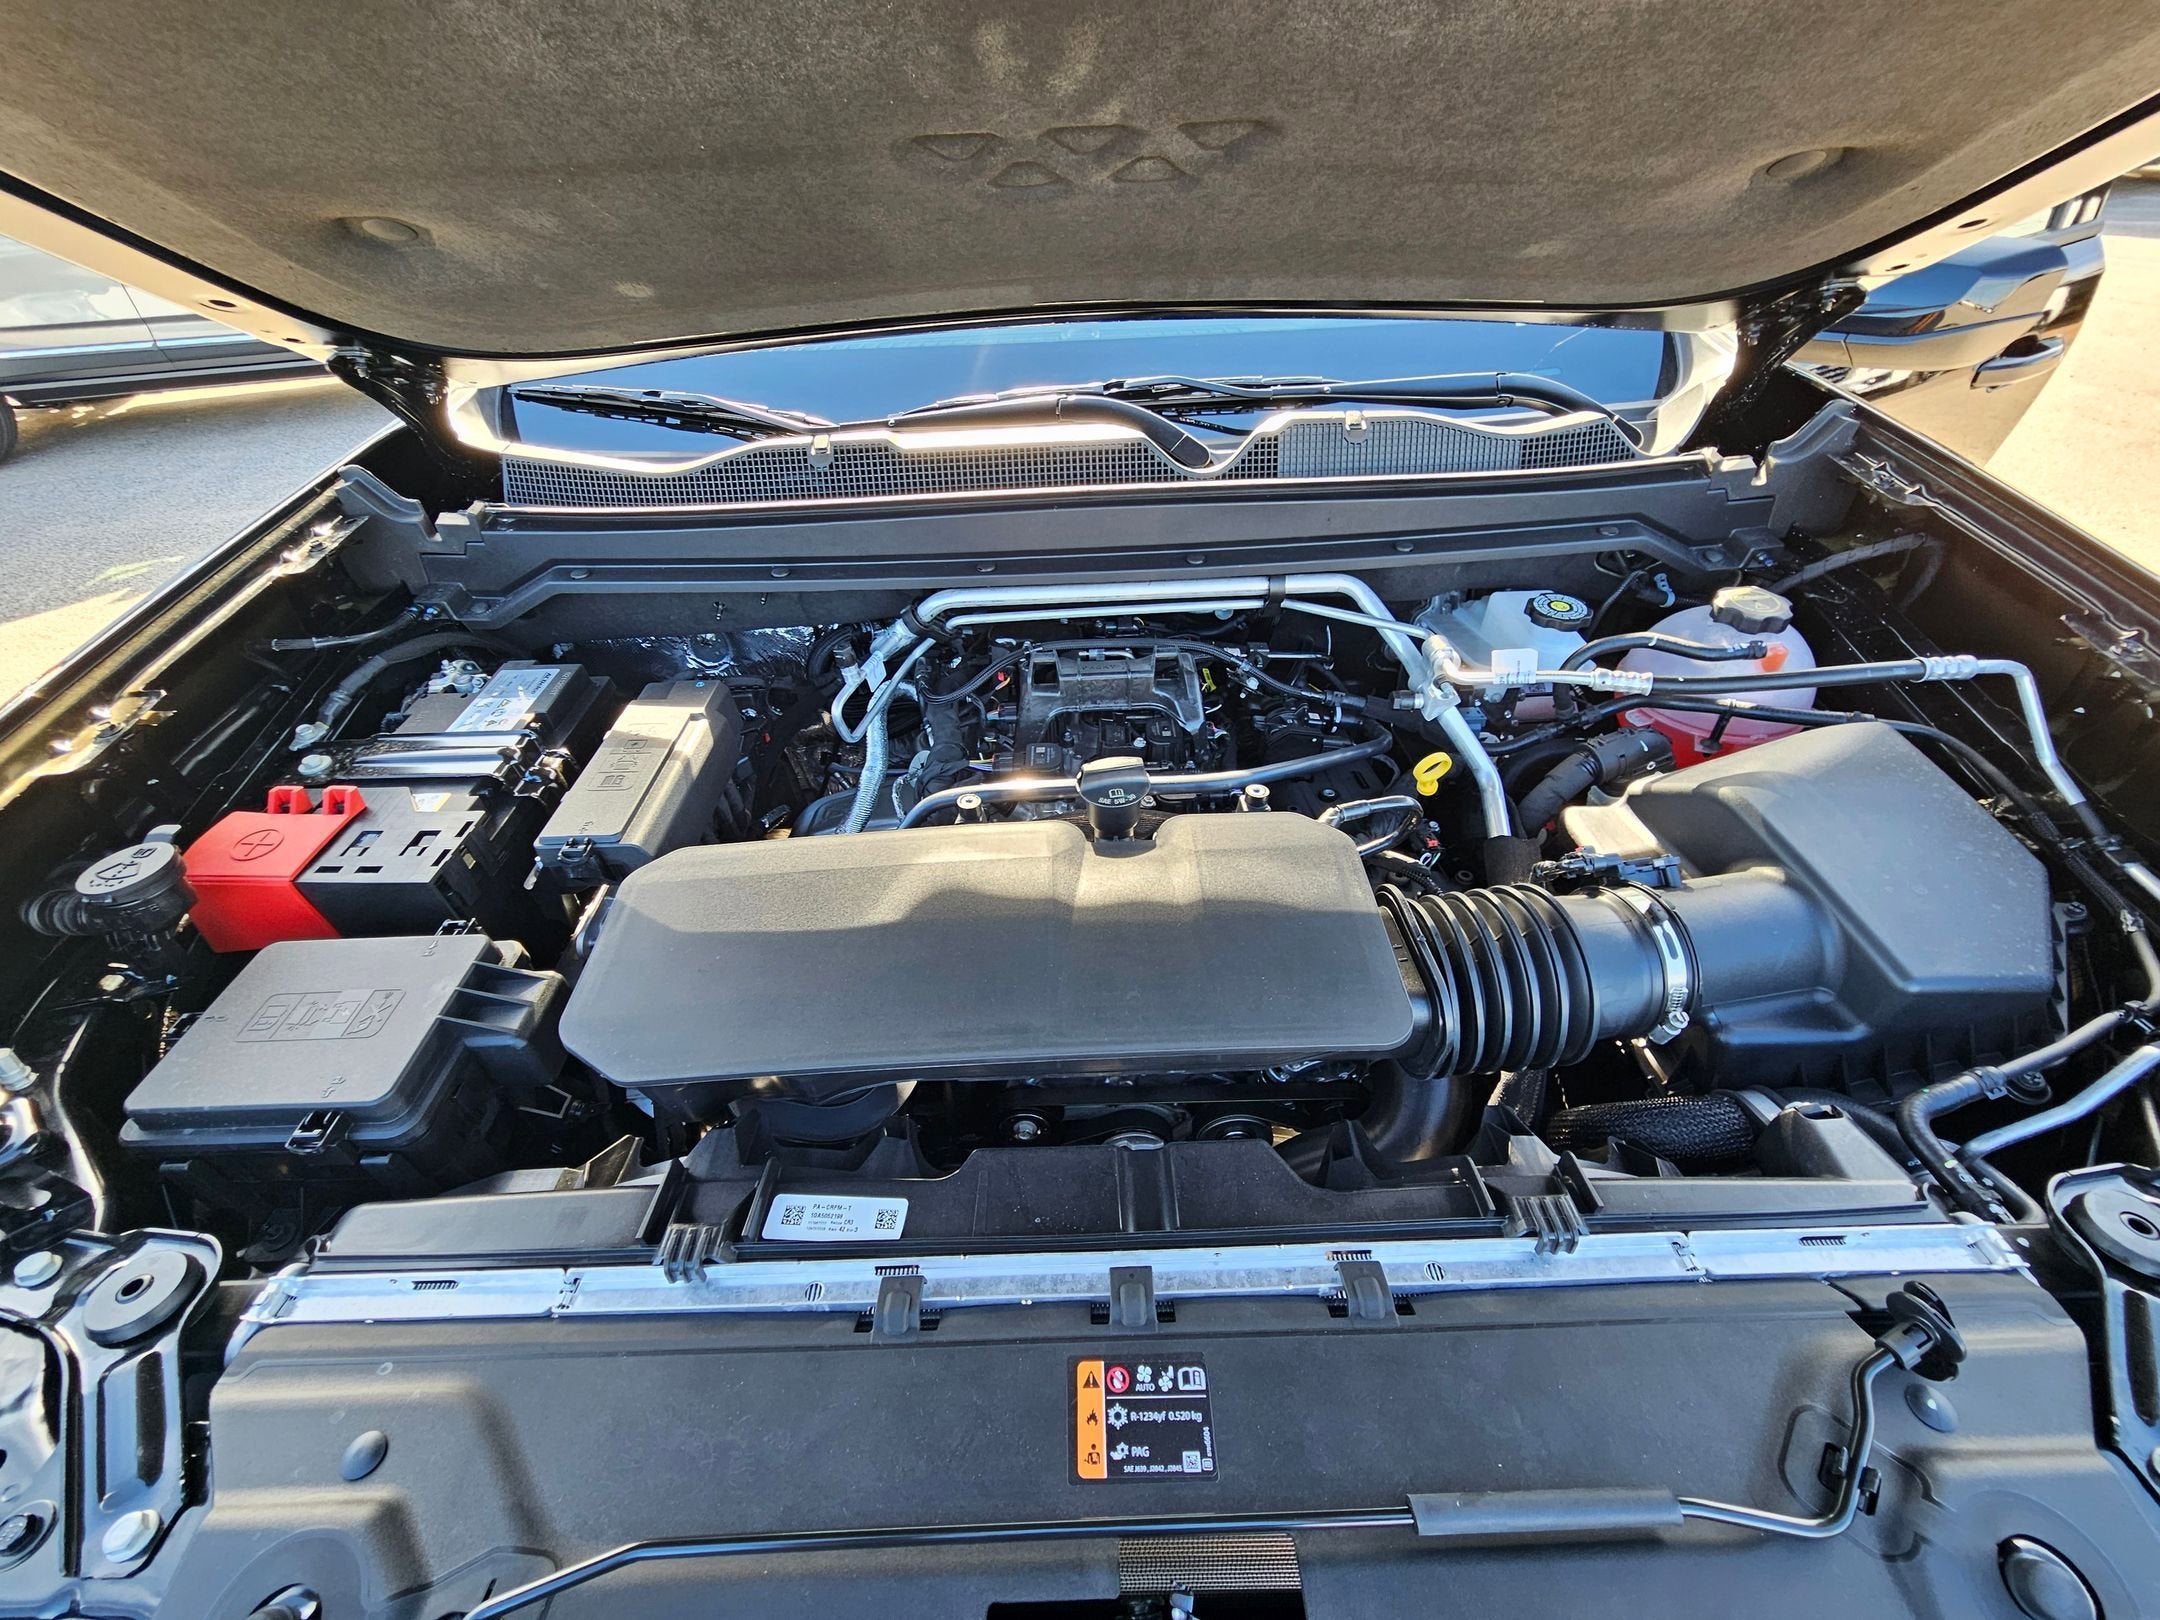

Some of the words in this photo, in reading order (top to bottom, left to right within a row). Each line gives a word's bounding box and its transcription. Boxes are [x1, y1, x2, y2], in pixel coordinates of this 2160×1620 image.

[1130, 1411, 1166, 1423] R-1234yf
[1168, 1411, 1191, 1421] 0.520
[1191, 1411, 1203, 1422] kg
[1131, 1447, 1150, 1457] PAG
